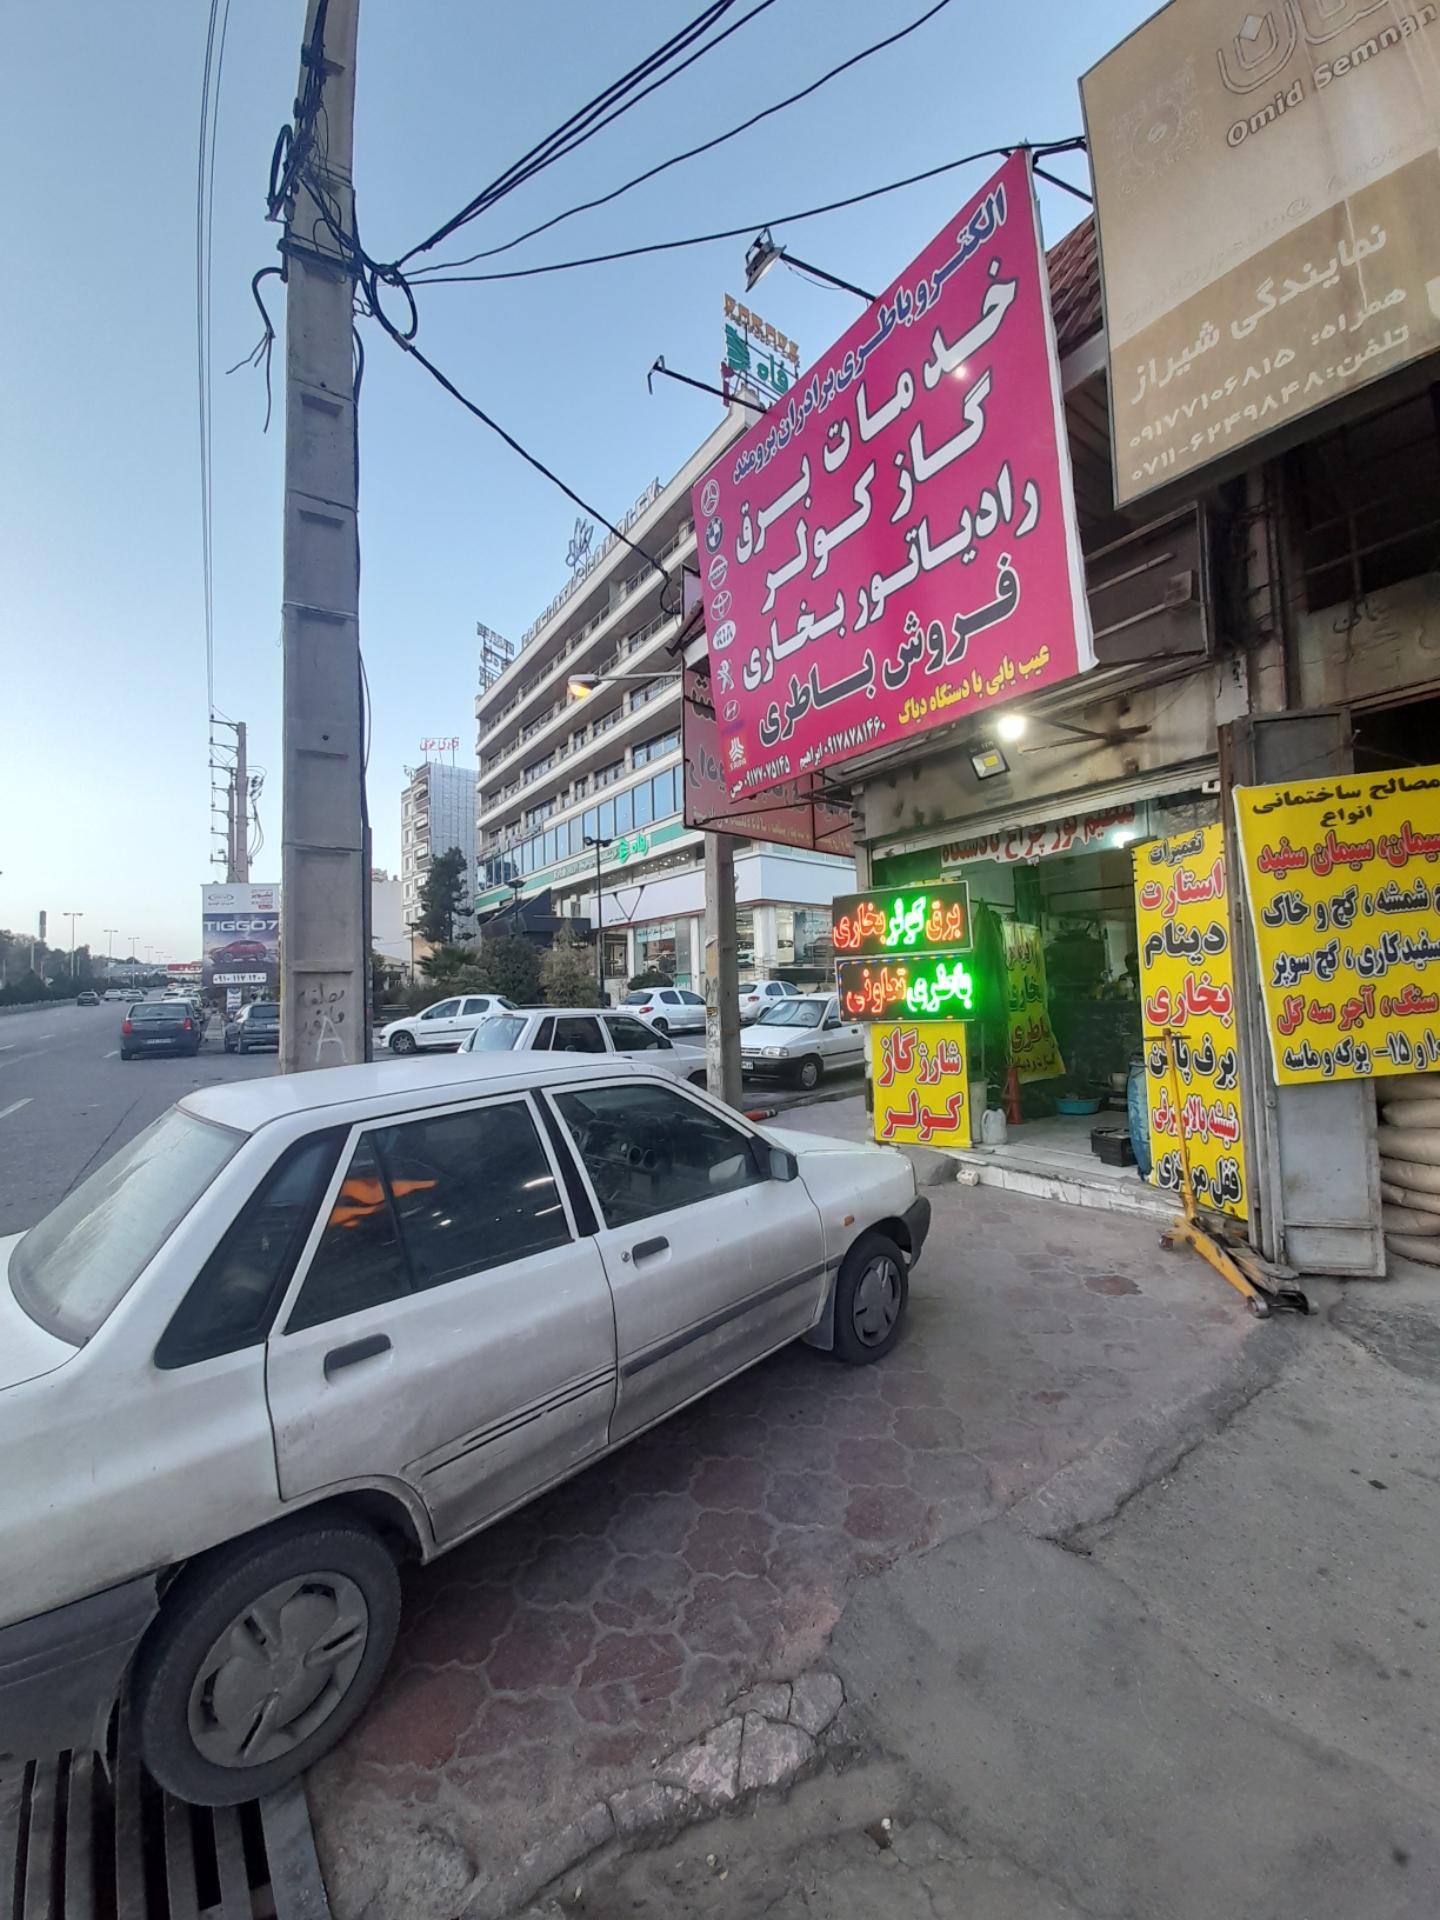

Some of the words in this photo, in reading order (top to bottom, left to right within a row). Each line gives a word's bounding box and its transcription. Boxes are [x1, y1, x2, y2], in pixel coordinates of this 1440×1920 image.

[1226, 79, 1304, 147] Omid
[1313, 3, 1438, 90] Semnan
[1230, 225, 1387, 340] نمایندگی
[823, 257, 1018, 474] خدمات
[1131, 319, 1220, 405] شیراز
[777, 367, 835, 450] برادران
[1129, 348, 1296, 448] ۰۹۱۷۷۱۰۶۸۱۵
[733, 422, 777, 485] برومند
[890, 368, 992, 523] گاز
[736, 452, 812, 564] برق
[761, 461, 876, 614] کولر
[853, 461, 1041, 631] رادیاتور
[742, 590, 847, 690] بخاری
[882, 552, 1021, 689] فروش
[971, 668, 983, 698] با
[985, 655, 1015, 696] یابی
[1018, 644, 1050, 680] عیب
[759, 640, 876, 747] باطری
[929, 678, 970, 712] دستگاه
[1252, 784, 1362, 815] ساختمانی
[1369, 776, 1440, 801] مصالح
[1319, 804, 1374, 828] انواع
[1149, 831, 1206, 867] تعمیرات
[1257, 836, 1308, 879] سفید
[1311, 829, 1374, 875] سیمان
[1140, 859, 1224, 917] استارت
[1262, 890, 1311, 927] خاک
[1330, 885, 1358, 928] گچ
[833, 902, 887, 948] بخاری
[886, 896, 927, 946] کولر
[925, 900, 961, 941] برق
[1314, 902, 1328, 932] و
[1144, 919, 1228, 969] دینام
[1314, 937, 1340, 981] گچ
[906, 963, 973, 1012] باطری
[1271, 951, 1311, 987] سوپر
[1145, 972, 1234, 1027] بخاری
[1277, 994, 1305, 1034] گل
[1308, 1000, 1335, 1025] سه
[1338, 985, 1376, 1029] آجر
[878, 1027, 918, 1087] گاز
[917, 1039, 962, 1084] شارژ
[1193, 1033, 1237, 1089] برف
[1284, 1040, 1321, 1070] ماسه
[1322, 1049, 1334, 1076] و
[1333, 1037, 1373, 1073] پوکه
[881, 1089, 964, 1141] کولر
[1208, 1099, 1240, 1150] شیشه
[1157, 1149, 1209, 1200] مرزی
[1211, 1155, 1242, 1209] قفل
